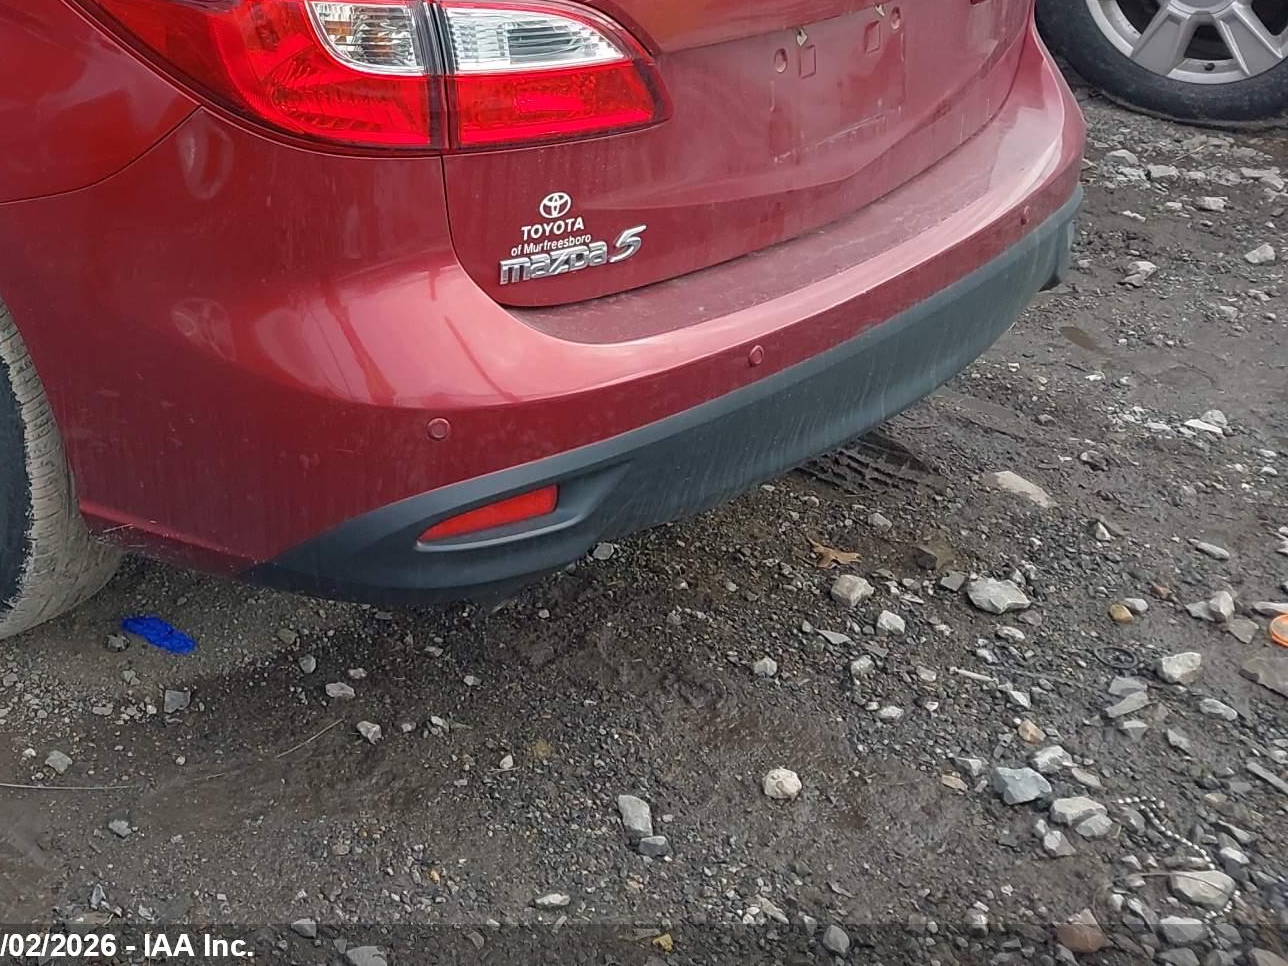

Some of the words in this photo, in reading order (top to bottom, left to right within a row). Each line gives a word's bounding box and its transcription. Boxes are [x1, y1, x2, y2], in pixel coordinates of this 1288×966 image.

[520, 216, 585, 241] TOYOTA
[511, 244, 523, 257] of
[524, 233, 592, 255] Murfreesboro
